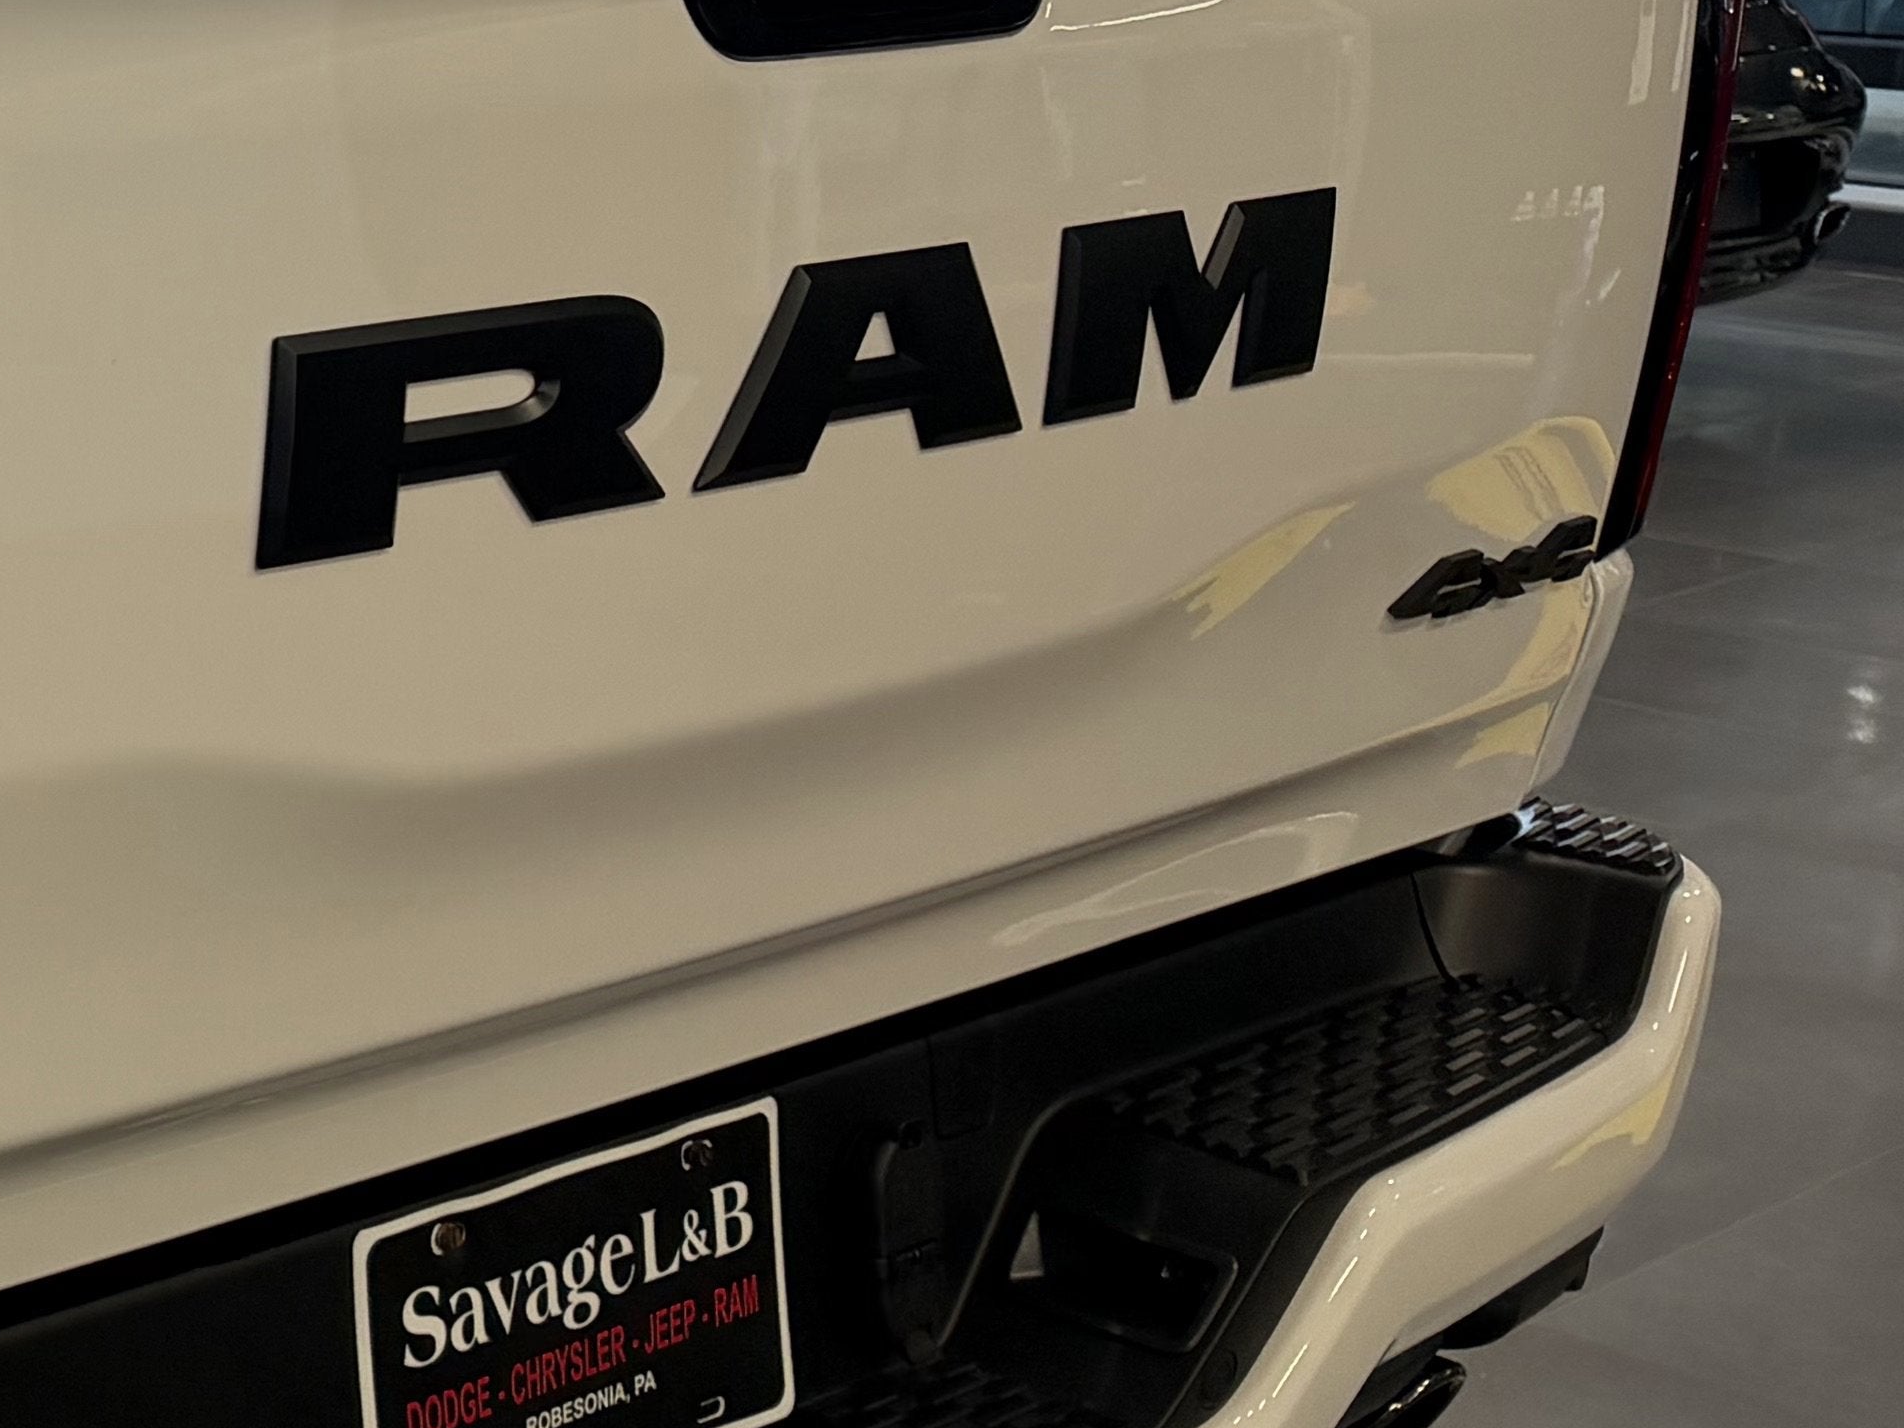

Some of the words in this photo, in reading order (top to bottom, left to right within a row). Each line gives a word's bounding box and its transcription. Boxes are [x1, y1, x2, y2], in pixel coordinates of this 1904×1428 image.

[255, 186, 1337, 570] RAM
[511, 1325, 626, 1405] CHRYSLER
[645, 1299, 695, 1354] JEEP
[714, 1274, 760, 1327] RAM
[634, 1371, 657, 1396] PA
